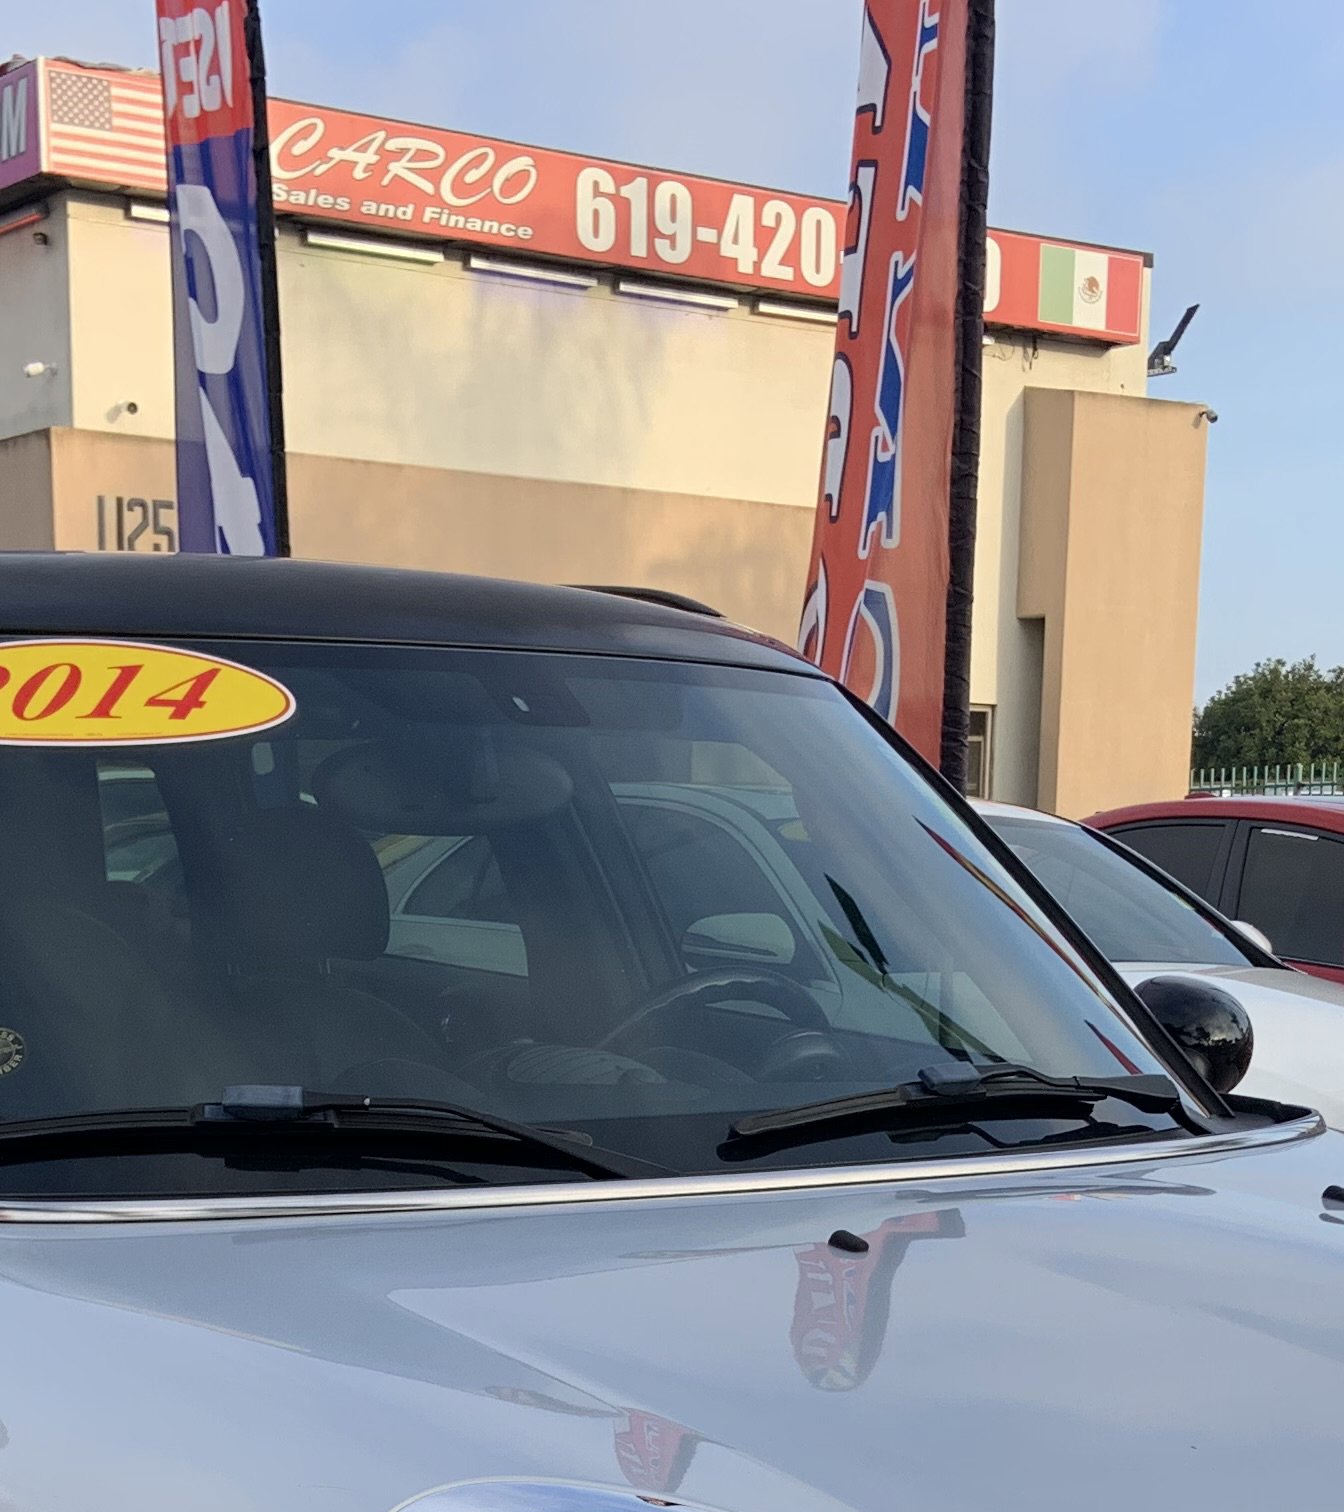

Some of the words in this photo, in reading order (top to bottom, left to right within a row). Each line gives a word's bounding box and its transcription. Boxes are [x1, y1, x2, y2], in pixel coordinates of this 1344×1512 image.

[269, 117, 538, 207] CARCO
[270, 183, 351, 210] Sales
[361, 199, 414, 222] and
[422, 206, 533, 240] Finance
[97, 495, 176, 551] 1125
